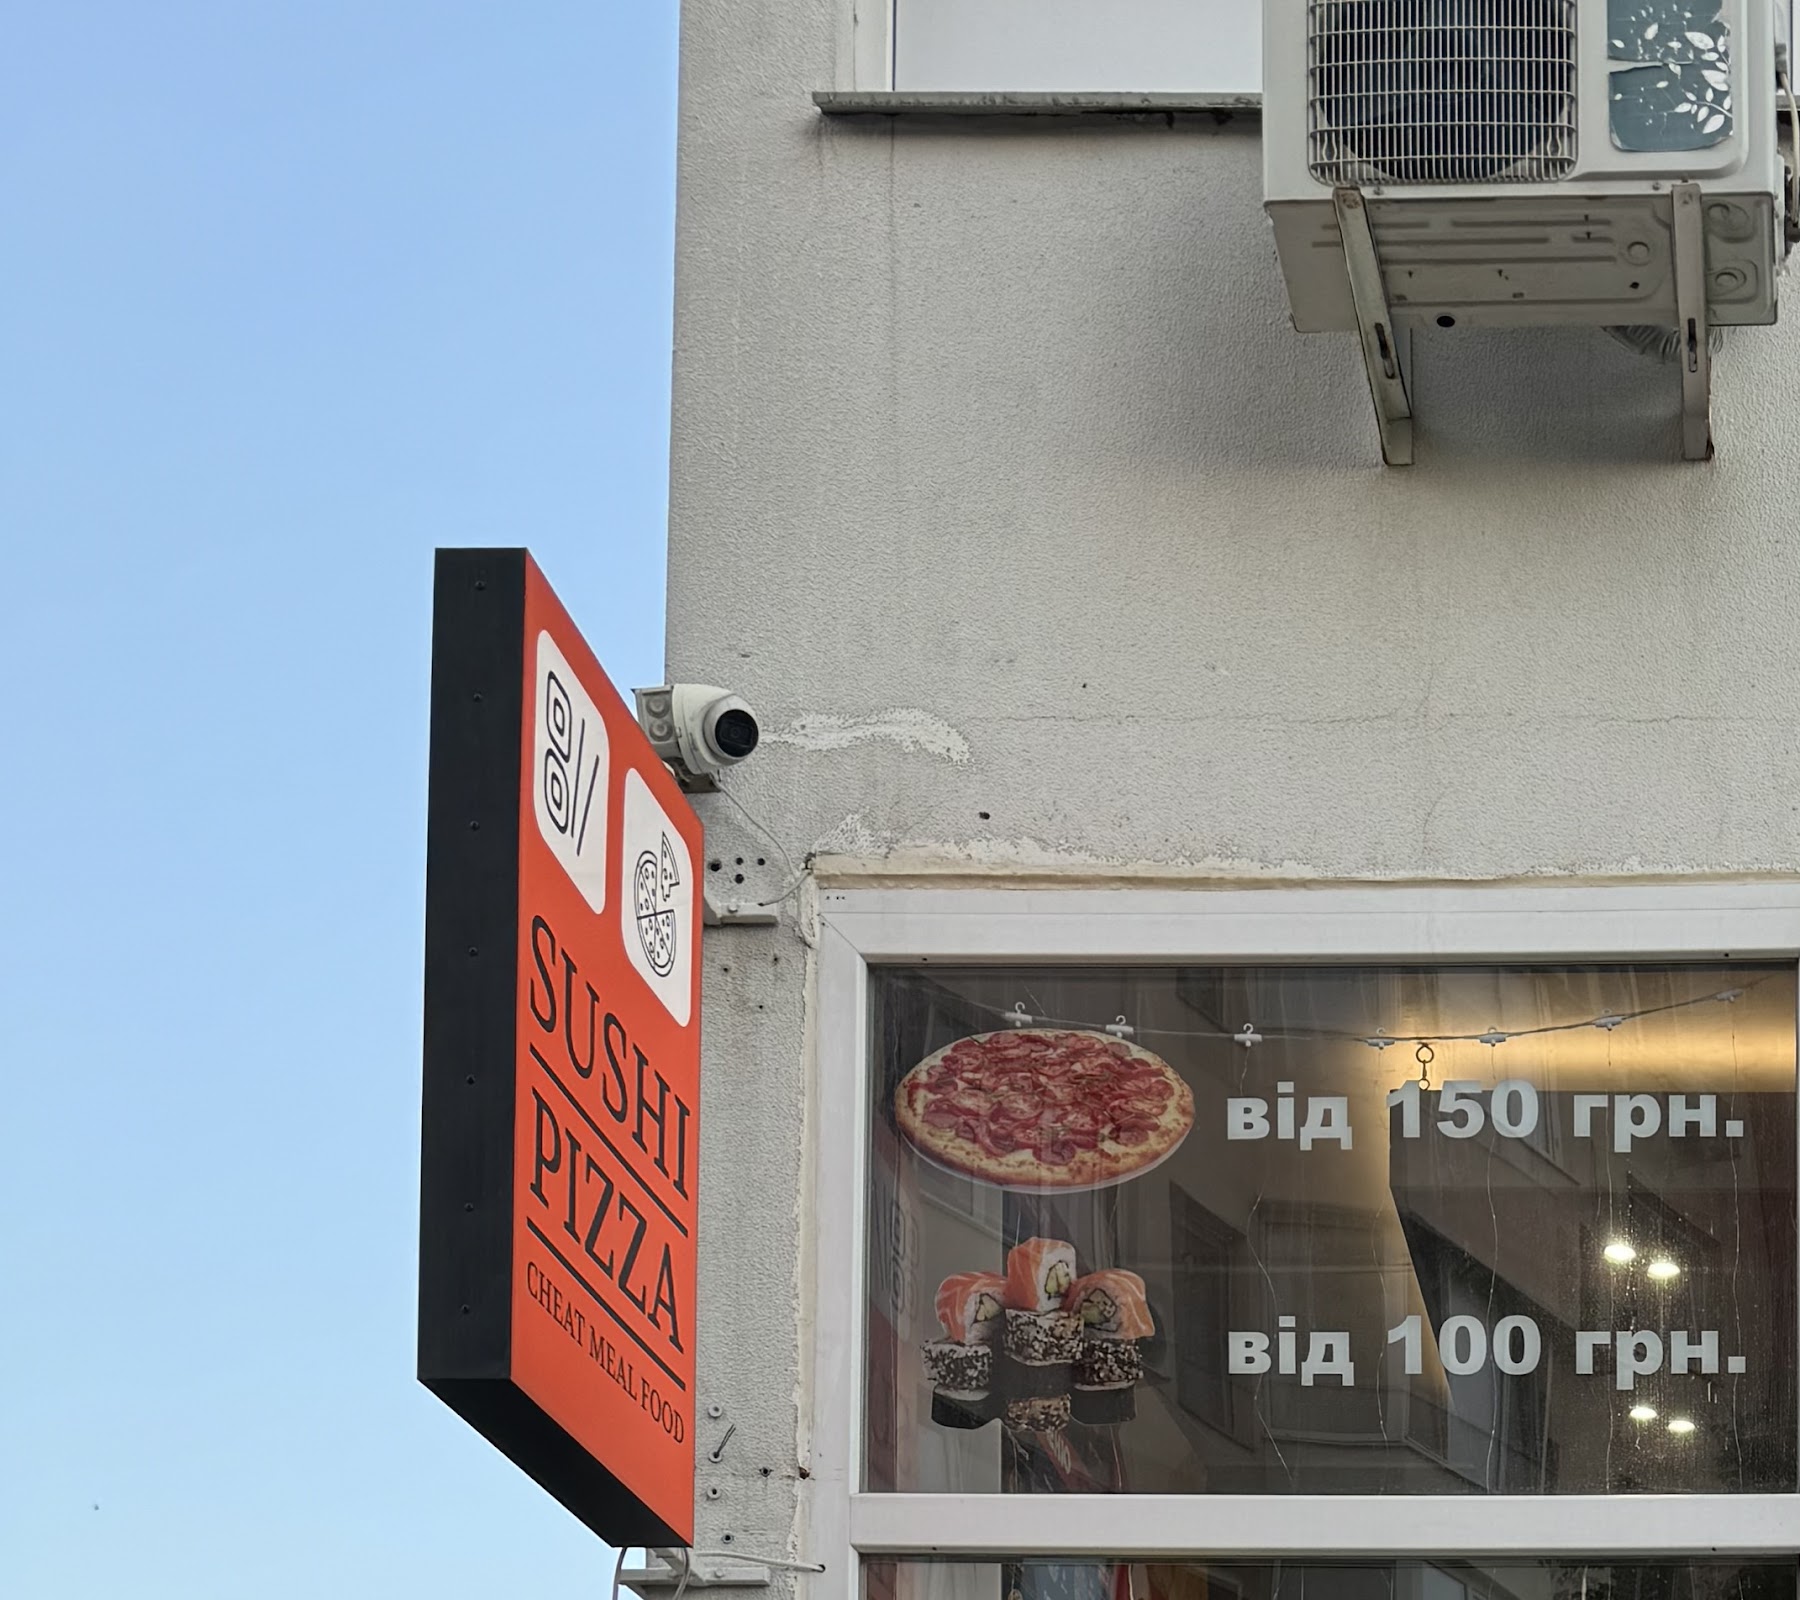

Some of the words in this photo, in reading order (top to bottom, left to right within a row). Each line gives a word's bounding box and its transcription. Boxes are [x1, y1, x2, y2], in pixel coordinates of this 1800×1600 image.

[530, 915, 690, 1202] SUSHI
[1226, 1081, 1353, 1151] від
[1385, 1079, 1540, 1140] 150
[1573, 1092, 1745, 1153] грн.
[530, 1085, 685, 1356] PIZZA
[526, 1261, 586, 1347] CHEAT
[589, 1325, 637, 1401] MEAL
[641, 1376, 684, 1444] FOOD
[1227, 1315, 1355, 1387] від
[1386, 1314, 1542, 1377] 100
[1574, 1329, 1747, 1391] грн.
